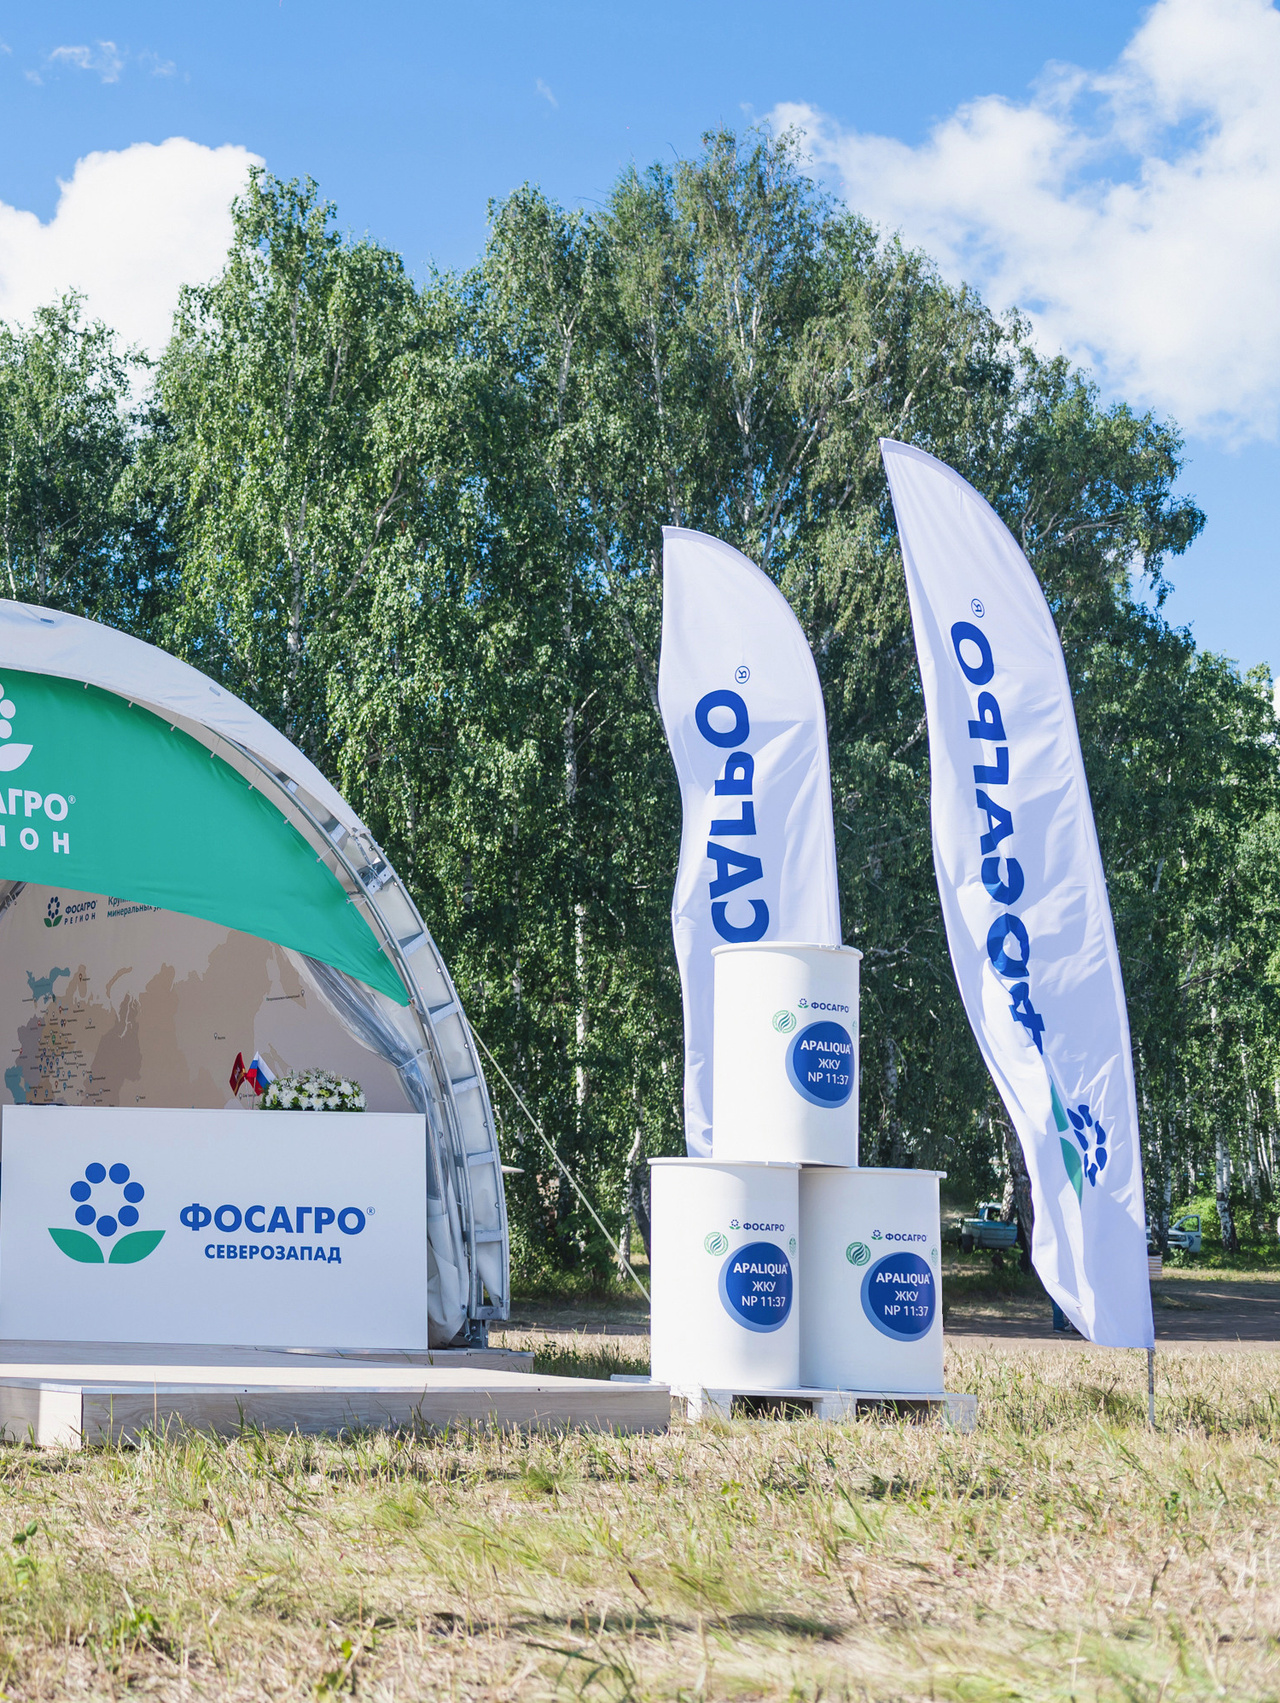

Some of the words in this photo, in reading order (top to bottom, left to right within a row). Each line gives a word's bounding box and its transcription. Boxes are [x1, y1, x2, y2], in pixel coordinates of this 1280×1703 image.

[65, 900, 97, 914] ФОСАГРО
[64, 912, 96, 925] РЕГИОН
[810, 1001, 849, 1013] ФОСАГРО
[800, 1040, 851, 1055] APALIQUA
[818, 1057, 841, 1070] ЖКУ
[807, 1072, 823, 1083] NP
[826, 1073, 849, 1085] 11:37
[179, 1203, 366, 1235] ФОСАГРО
[742, 1222, 785, 1232] ФОСАГРО
[885, 1233, 927, 1242] ФОСАГРО
[204, 1244, 342, 1264] СЕВЕРОЗАПАД
[733, 1262, 788, 1277] APALIQUA
[876, 1272, 931, 1286] APALIQUA
[751, 1280, 776, 1292] ЖКУ
[741, 1295, 758, 1307] NP
[760, 1296, 786, 1308] 11:37
[894, 1290, 919, 1302] ЖКУ
[884, 1305, 901, 1316] NP
[903, 1306, 929, 1317] 11:37
